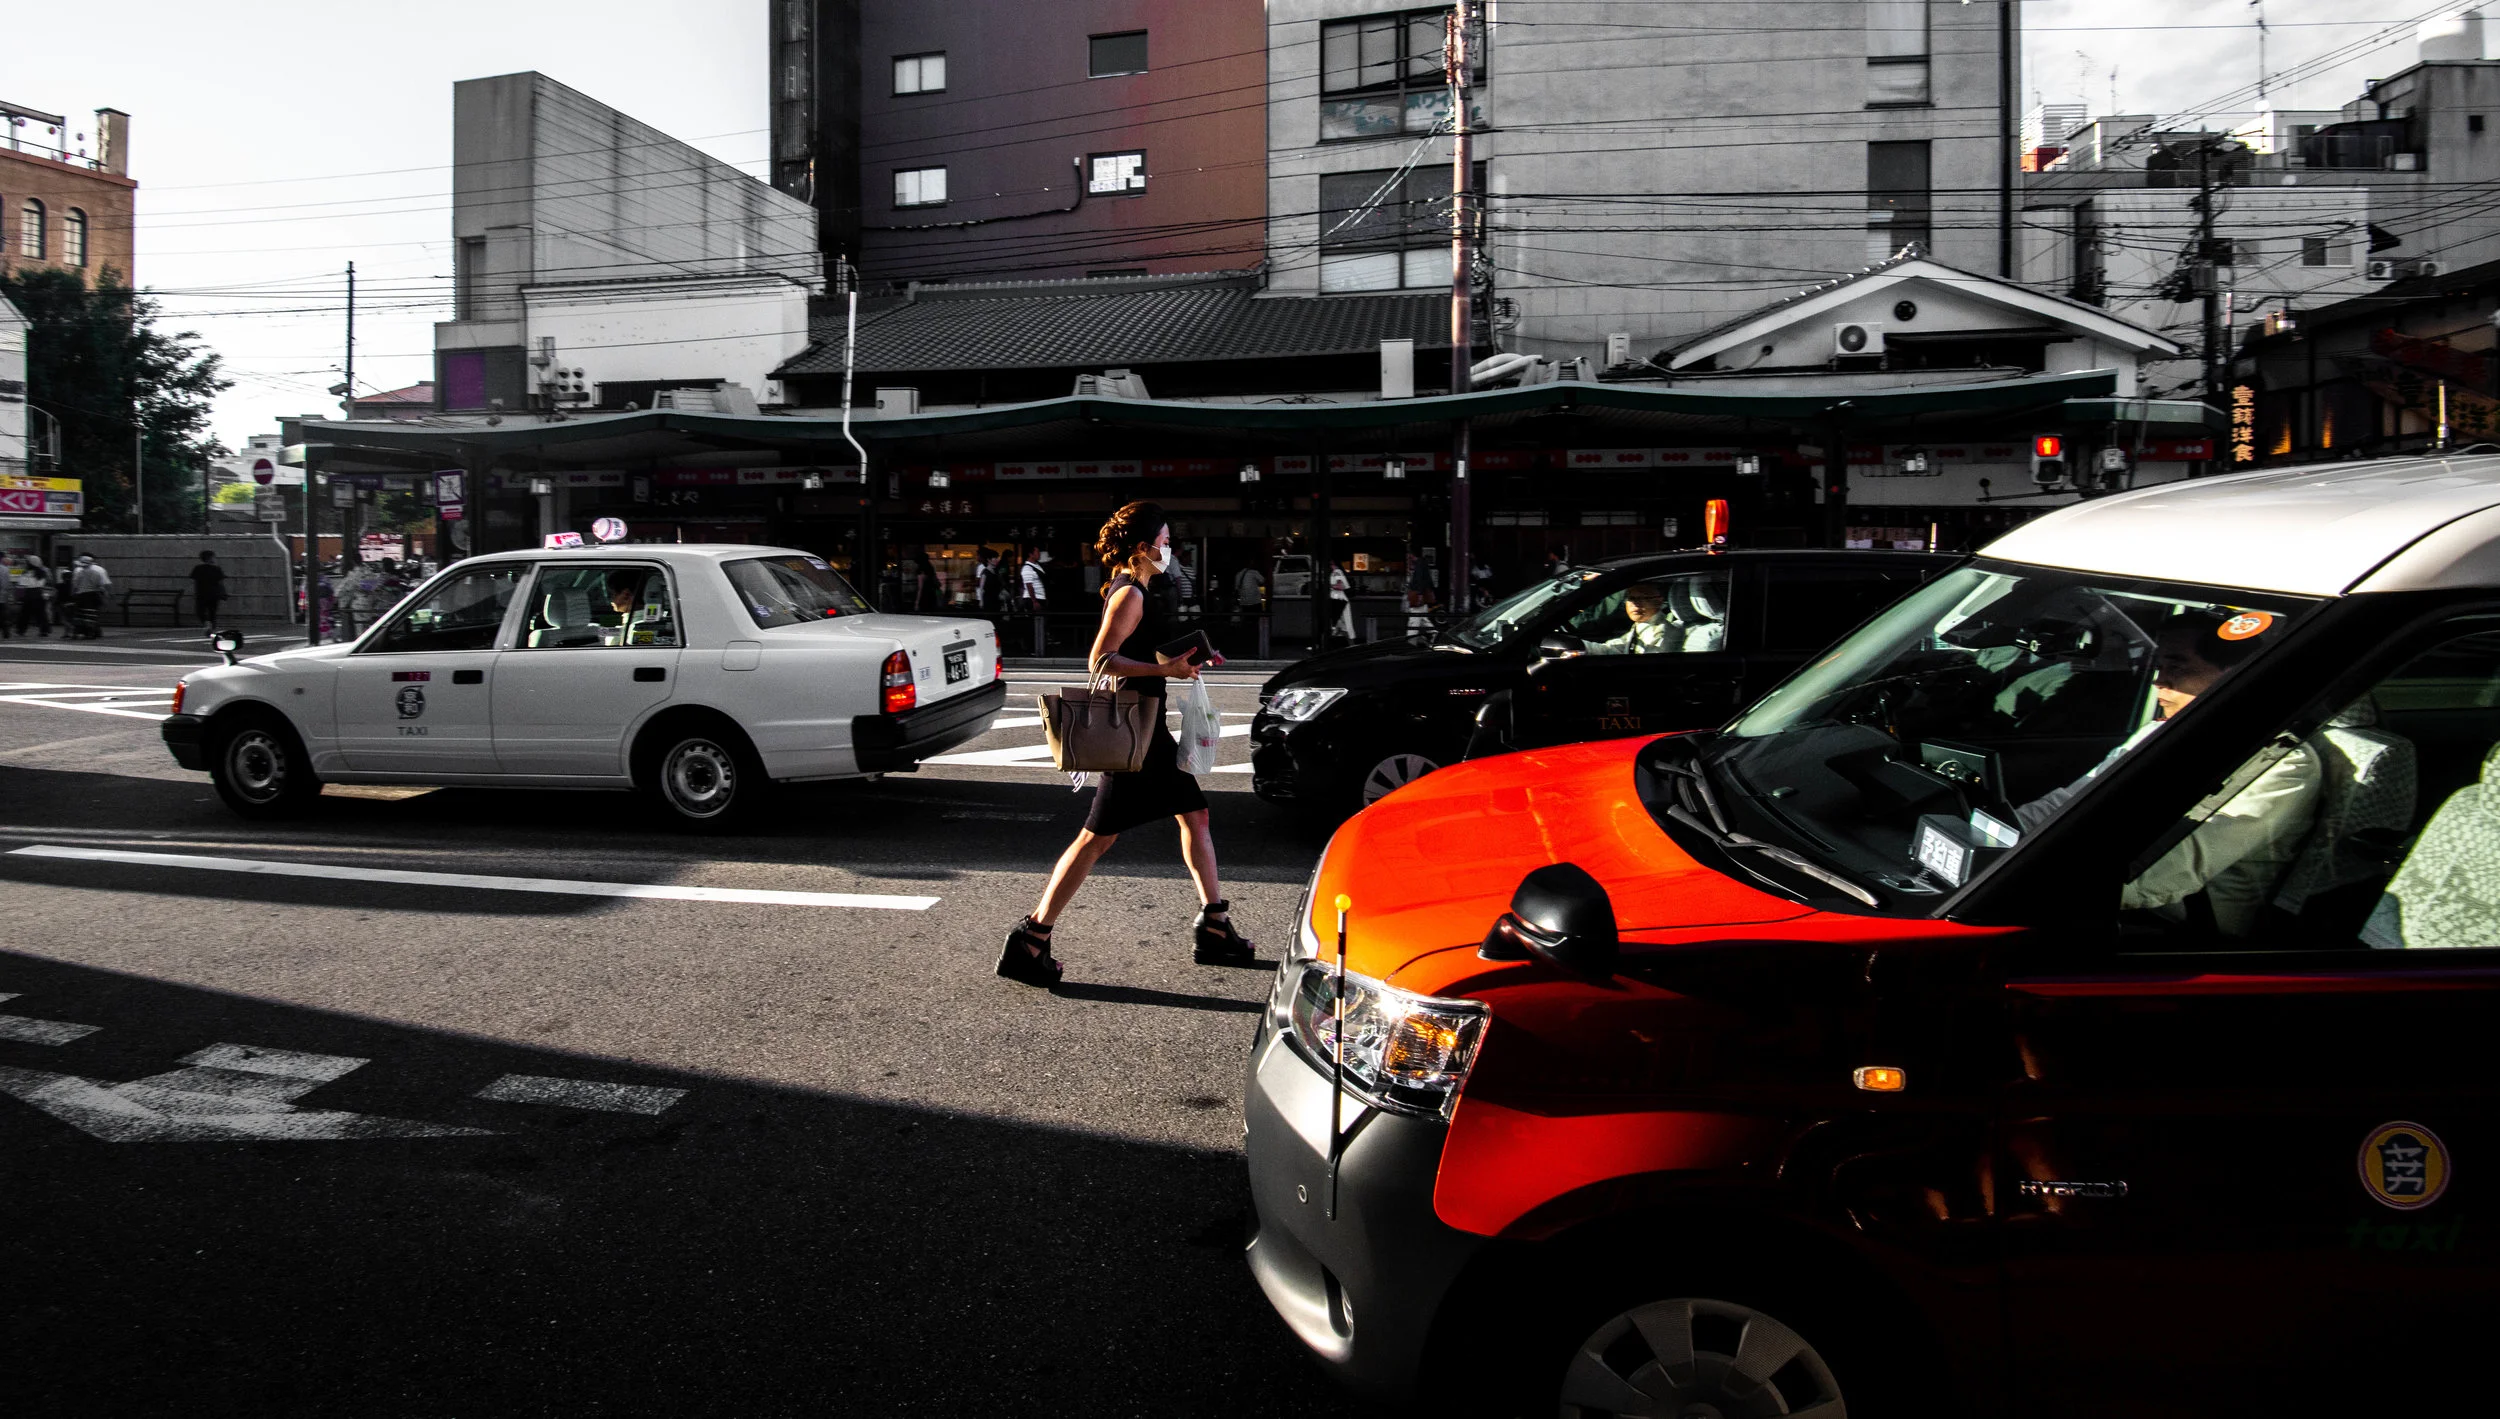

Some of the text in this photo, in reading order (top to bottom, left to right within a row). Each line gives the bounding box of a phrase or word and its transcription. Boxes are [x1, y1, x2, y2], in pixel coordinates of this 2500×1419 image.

[0, 491, 40, 510] くじ
[396, 726, 430, 737] TAXI
[1596, 716, 1641, 730] TAXI
[1919, 828, 1963, 885] 予約車
[2018, 1180, 2114, 1197] HYBRID
[2345, 1213, 2466, 1252] taxi
